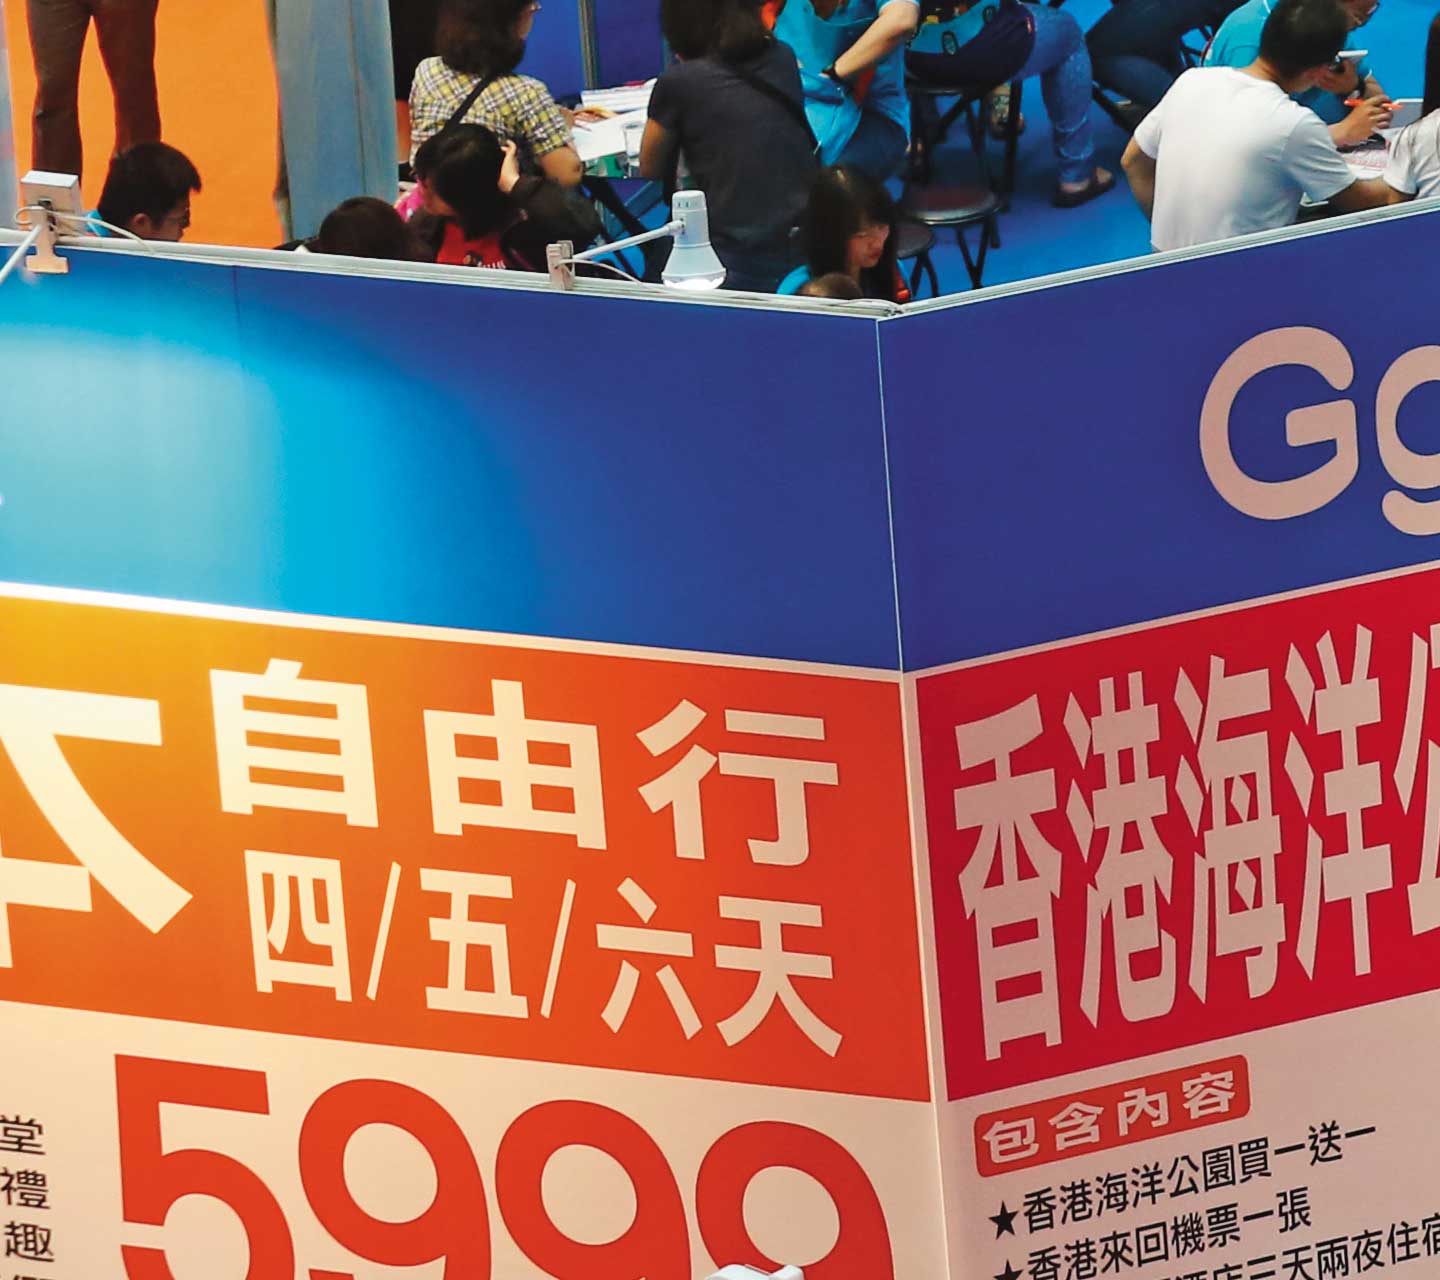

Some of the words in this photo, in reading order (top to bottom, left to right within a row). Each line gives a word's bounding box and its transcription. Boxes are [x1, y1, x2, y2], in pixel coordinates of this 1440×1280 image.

[207, 657, 841, 868] 自由行
[242, 848, 845, 1060] 四/五/六天
[113, 1051, 895, 1280] 5999
[982, 1069, 1240, 1166] 包含內容
[1022, 1117, 1379, 1238] 香港海洋公園買一送一
[1026, 1185, 1313, 1280] 香港來回機票一張
